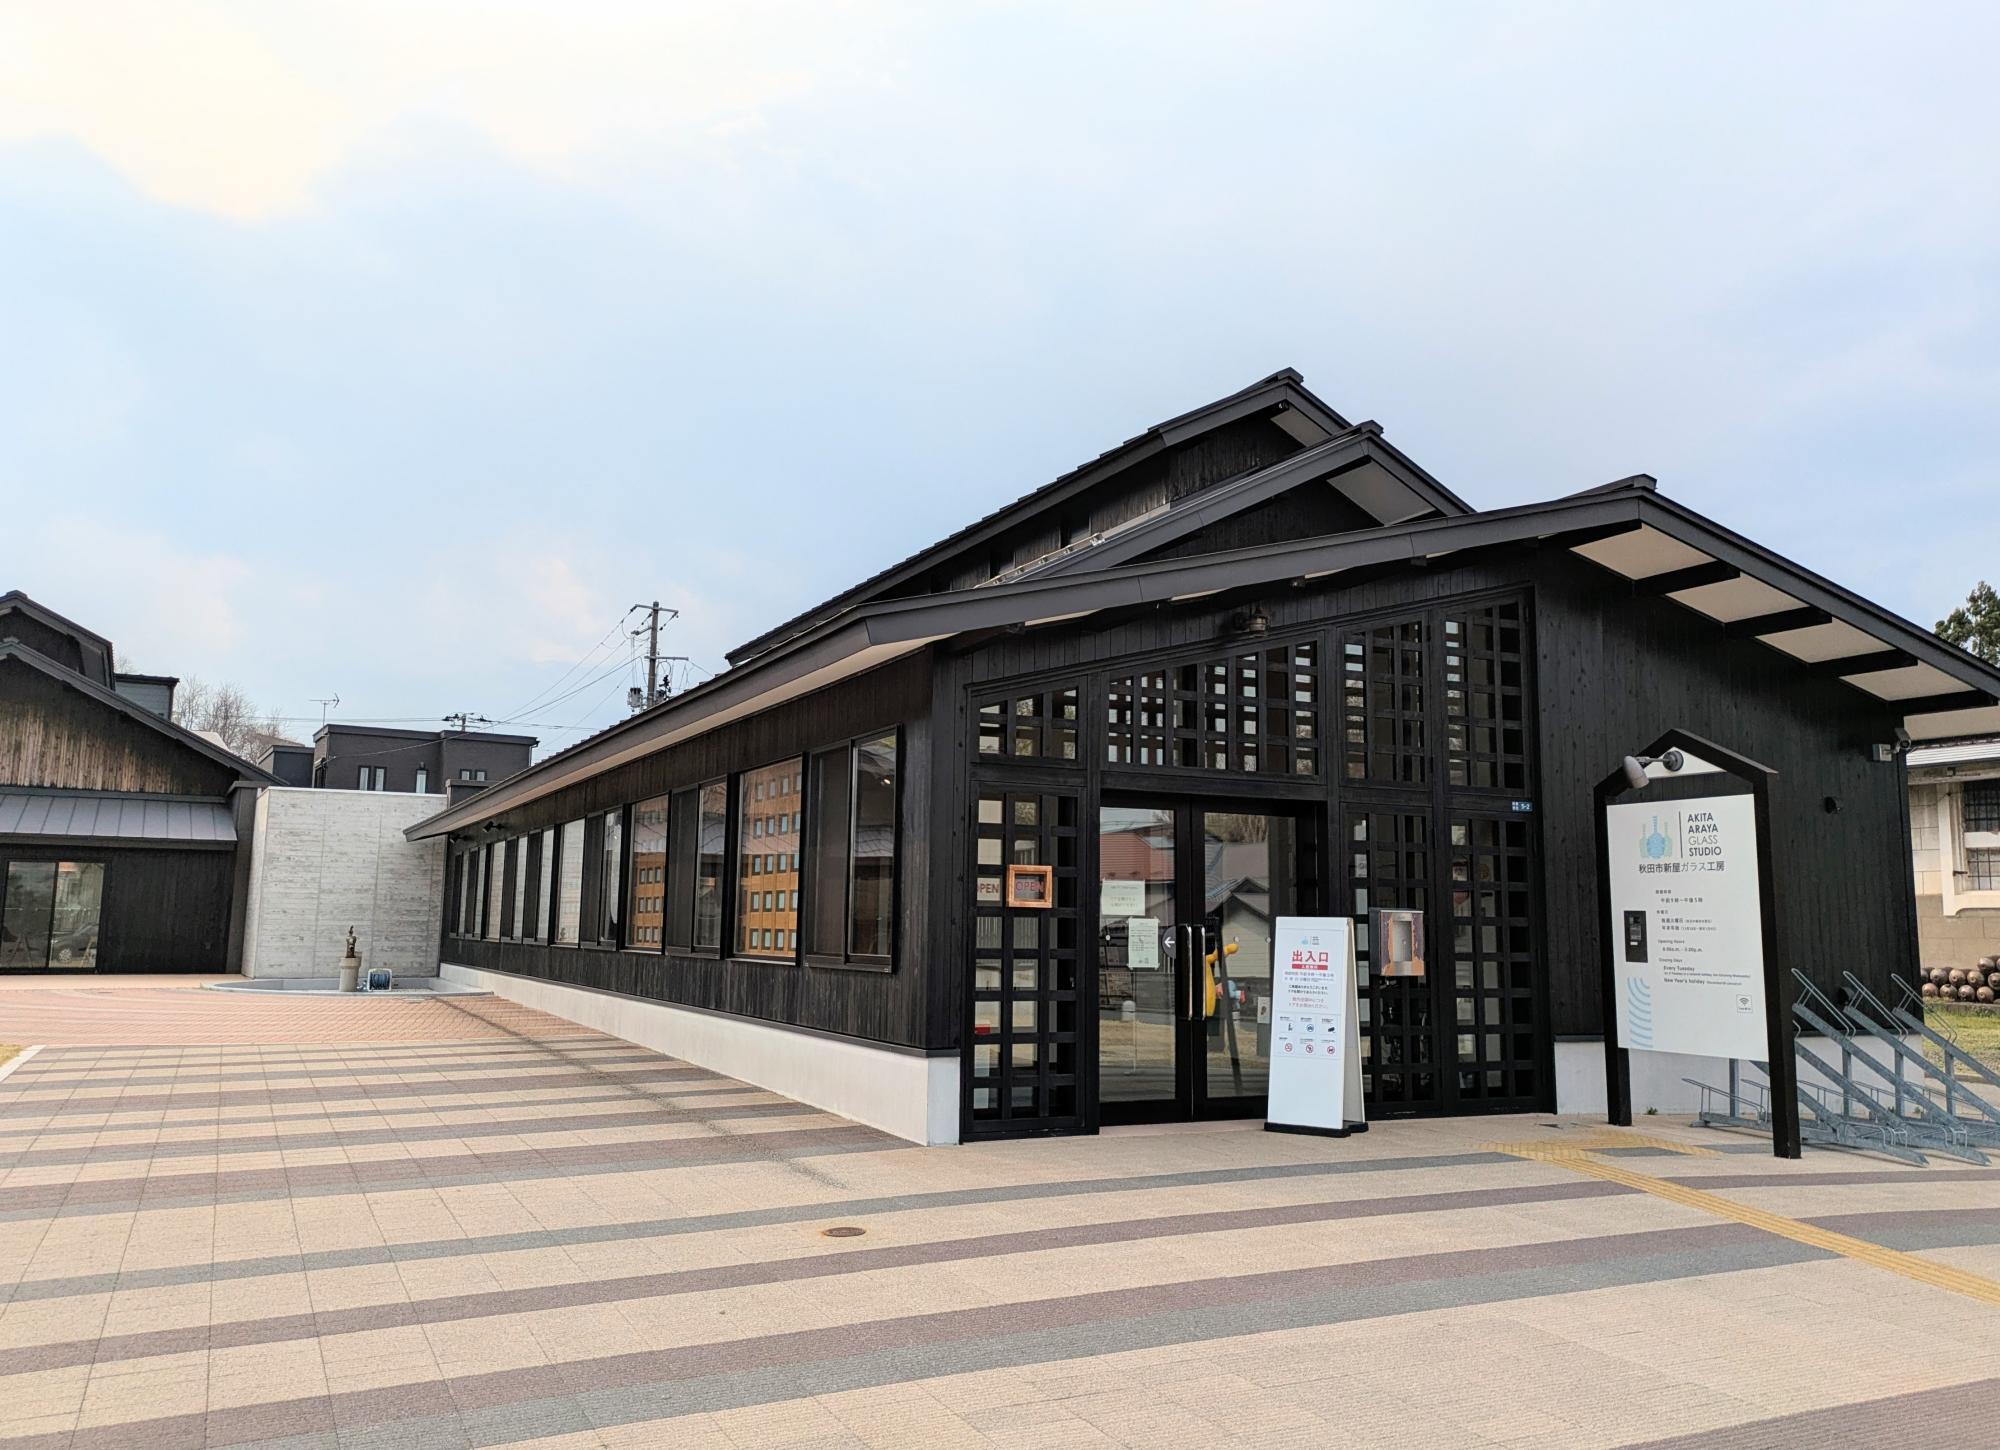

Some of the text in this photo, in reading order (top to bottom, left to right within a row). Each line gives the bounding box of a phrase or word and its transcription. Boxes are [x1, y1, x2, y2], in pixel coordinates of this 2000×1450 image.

[1687, 812, 1714, 823] AKITA
[1688, 823, 1719, 834] ARAYA
[1688, 834, 1718, 846] GLASS
[1689, 846, 1722, 857] STUDIO
[1639, 860, 1725, 874] 秋田市新屋ガラス工房
[1292, 950, 1329, 962] 出入口
